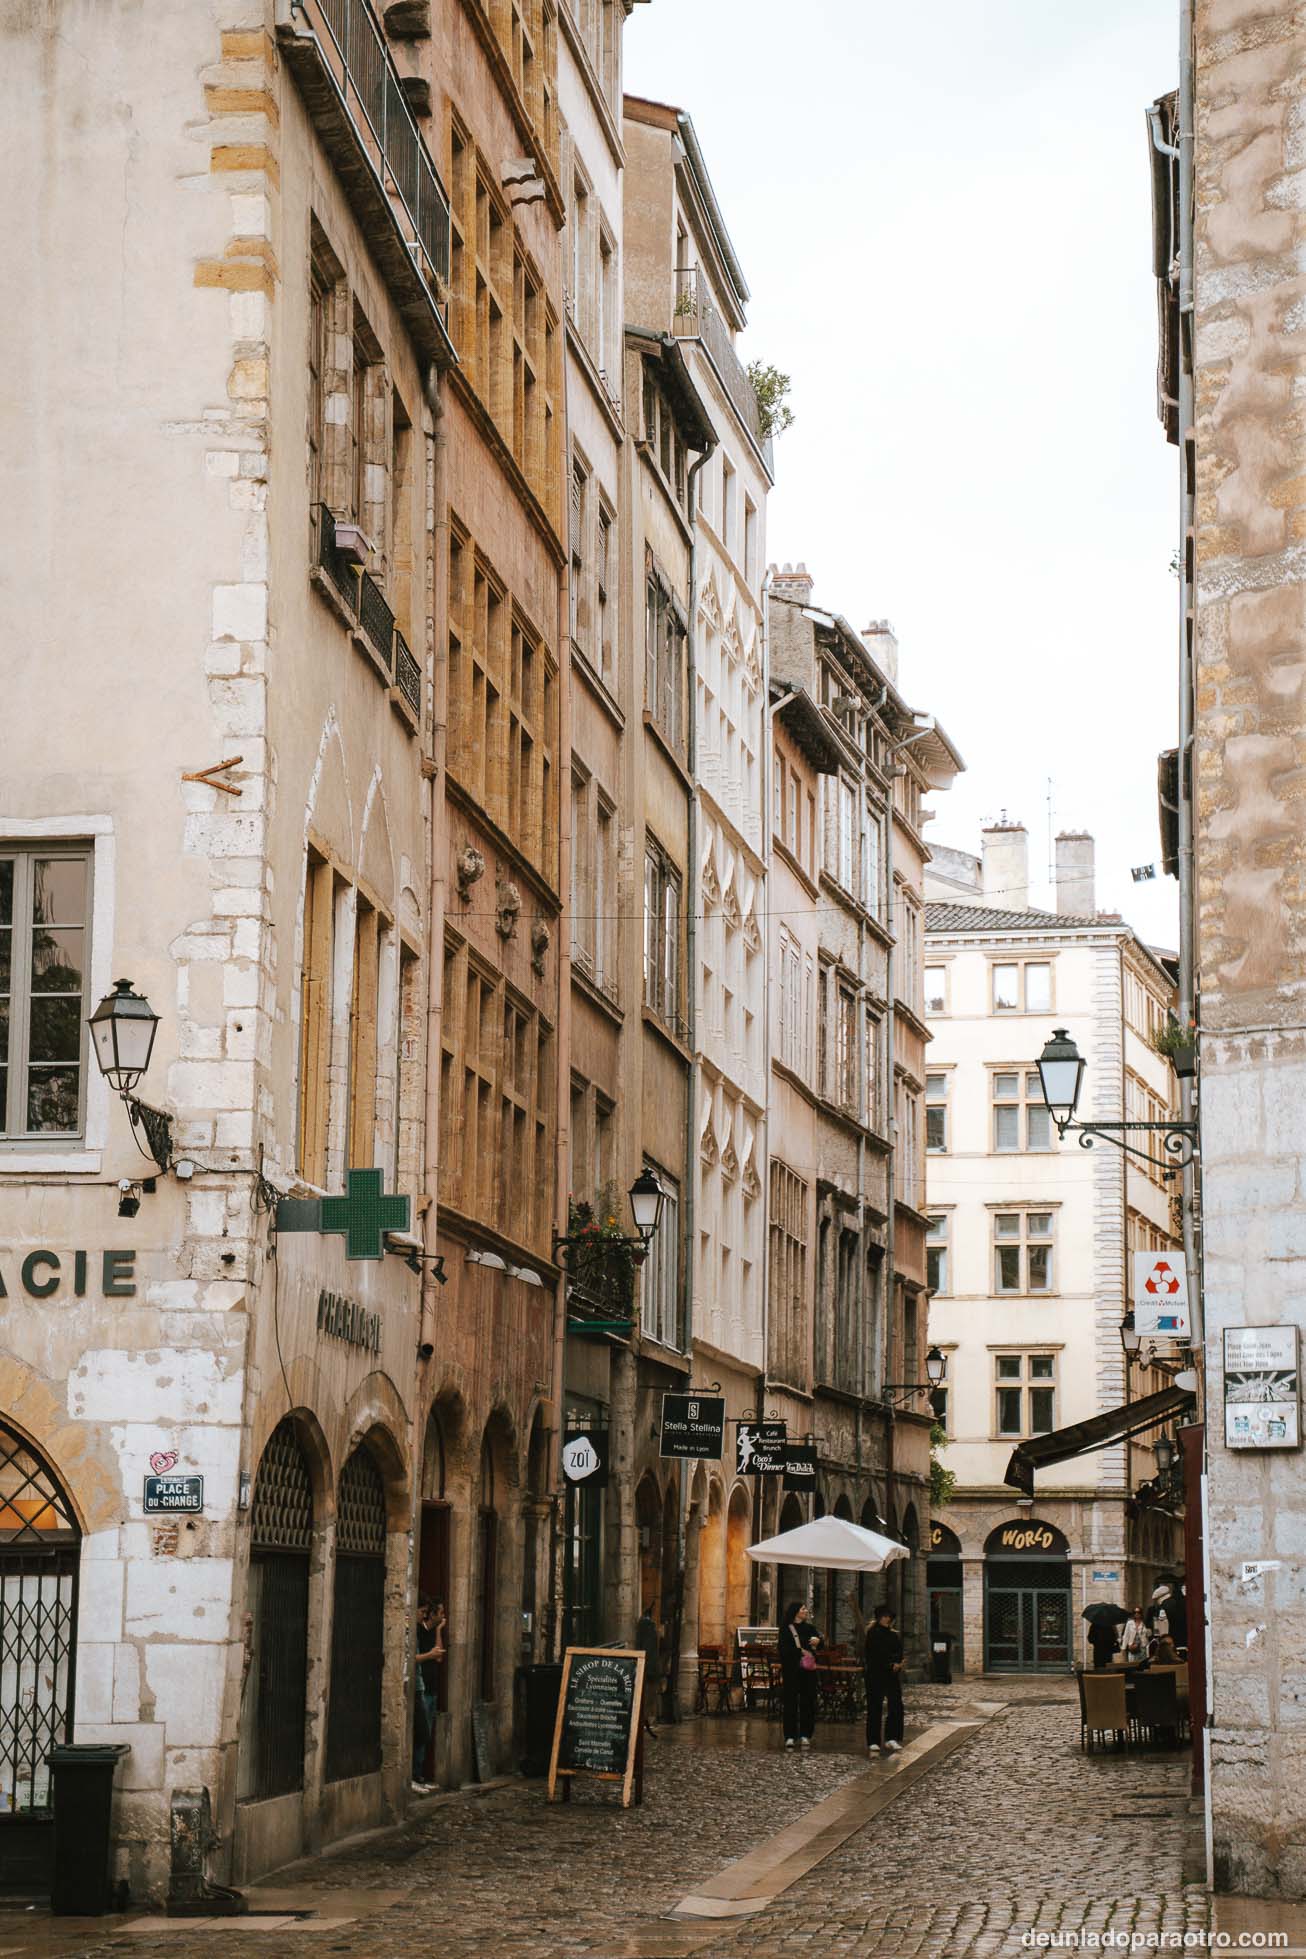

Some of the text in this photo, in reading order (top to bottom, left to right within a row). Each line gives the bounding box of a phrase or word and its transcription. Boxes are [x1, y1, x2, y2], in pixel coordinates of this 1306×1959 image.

[0, 1250, 136, 1298] CIE
[664, 1421, 721, 1433] Stella Stellina
[752, 1454, 773, 1465] Coco's
[757, 1462, 785, 1471] Dinner
[156, 1484, 190, 1494] PLACE
[148, 1495, 198, 1507] DU CHANGE
[1001, 1527, 1053, 1549] WORLD
[570, 1659, 633, 1693] LE SIROP DE LA RUE
